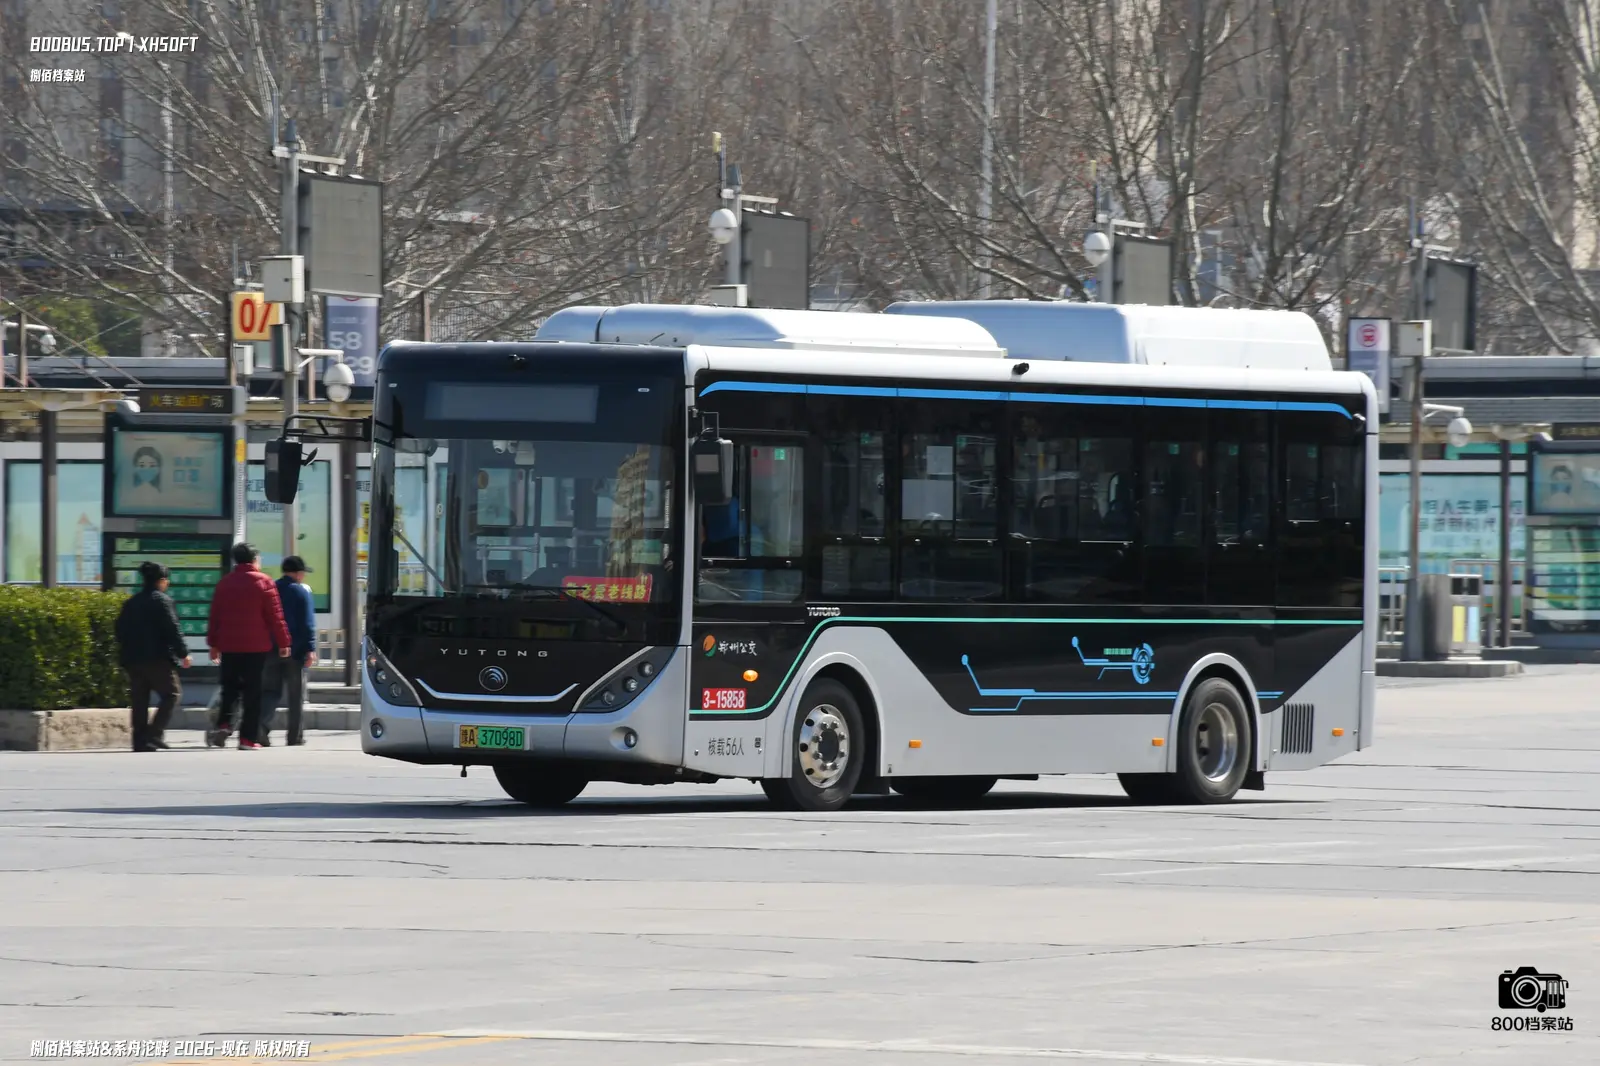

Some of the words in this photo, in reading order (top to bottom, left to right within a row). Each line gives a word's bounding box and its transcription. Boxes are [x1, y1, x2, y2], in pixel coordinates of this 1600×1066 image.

[328, 331, 362, 350] 58
[440, 648, 548, 657] YUTONG
[718, 641, 757, 656] 郑州公交
[703, 690, 745, 709] 3-15858
[708, 737, 745, 756] 核载56人
